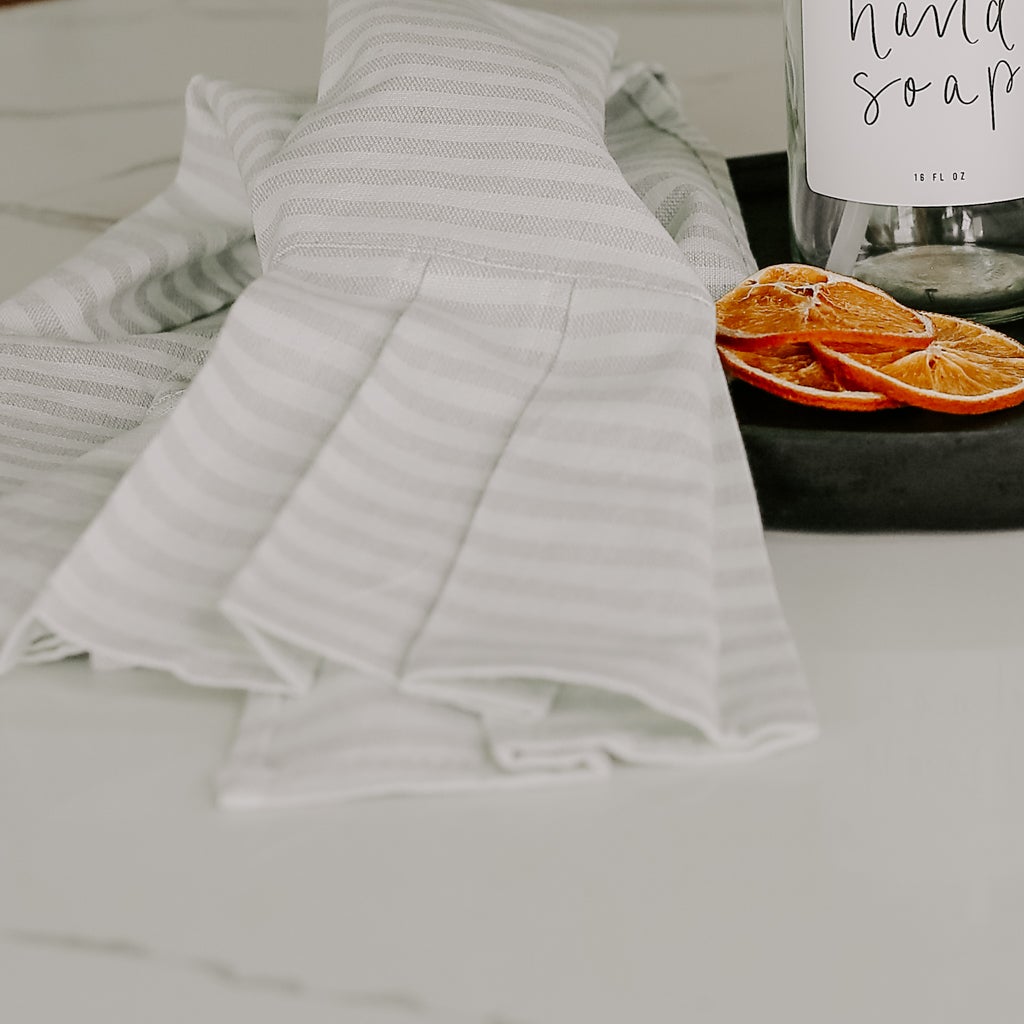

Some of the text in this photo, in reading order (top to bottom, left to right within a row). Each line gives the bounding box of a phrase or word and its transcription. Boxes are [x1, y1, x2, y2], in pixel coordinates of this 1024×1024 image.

[852, 59, 1021, 131] soap
[914, 171, 965, 182] 16 FL OZ
